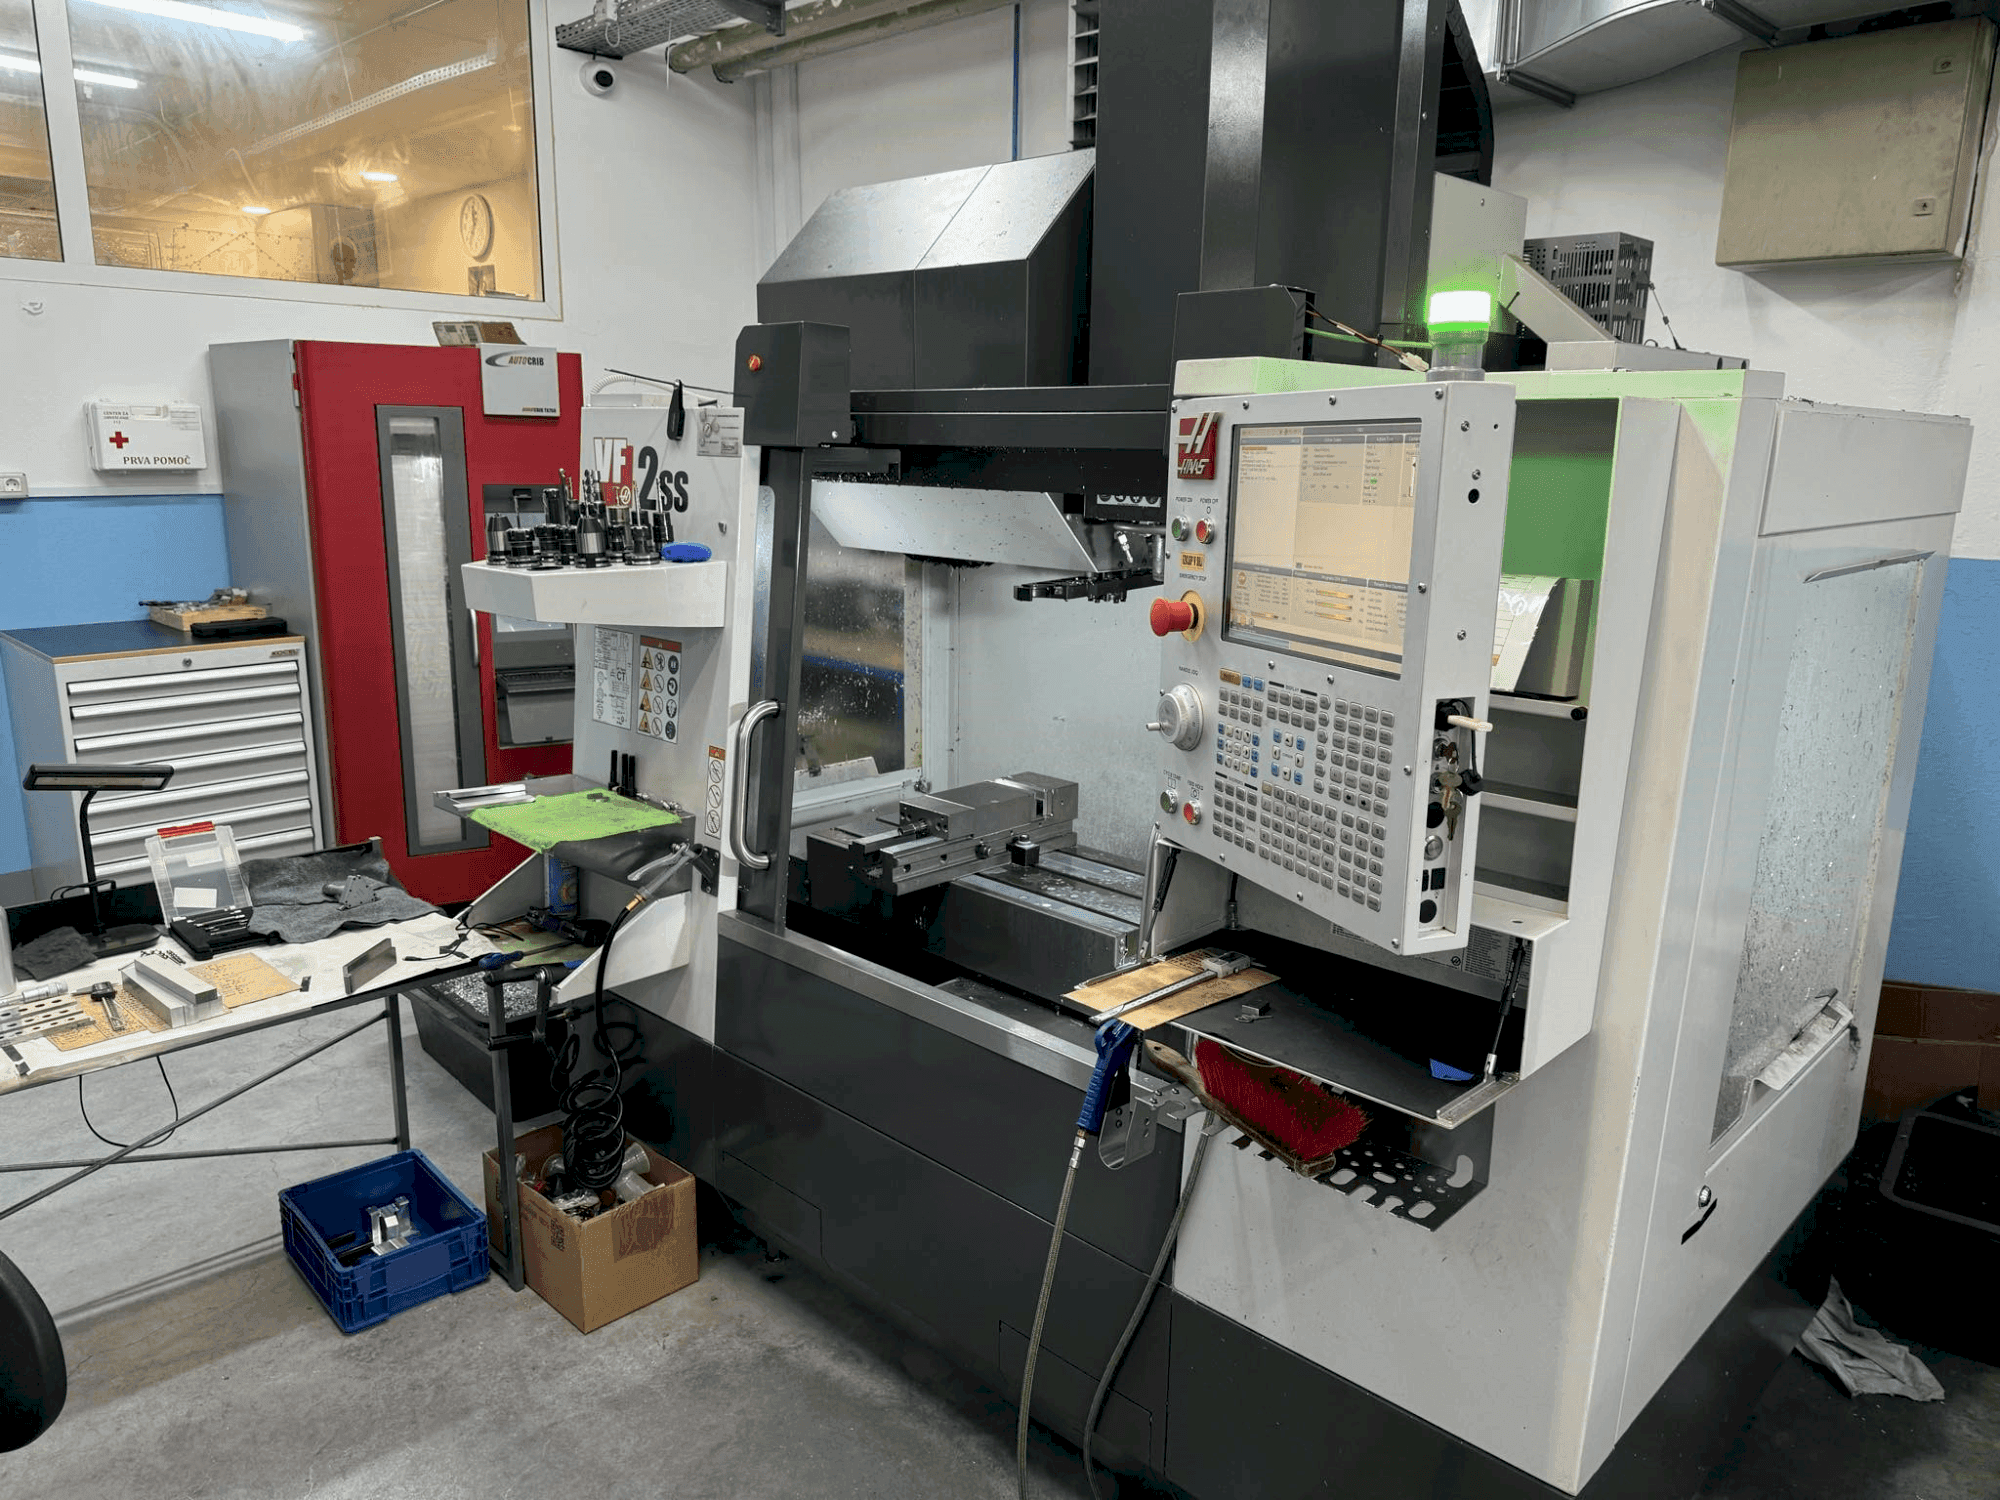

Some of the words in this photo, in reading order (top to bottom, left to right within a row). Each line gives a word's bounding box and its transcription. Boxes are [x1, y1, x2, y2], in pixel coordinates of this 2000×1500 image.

[508, 356, 544, 366] AUTOCRIB
[123, 456, 151, 465] PRVA
[153, 454, 191, 465] POMOČ
